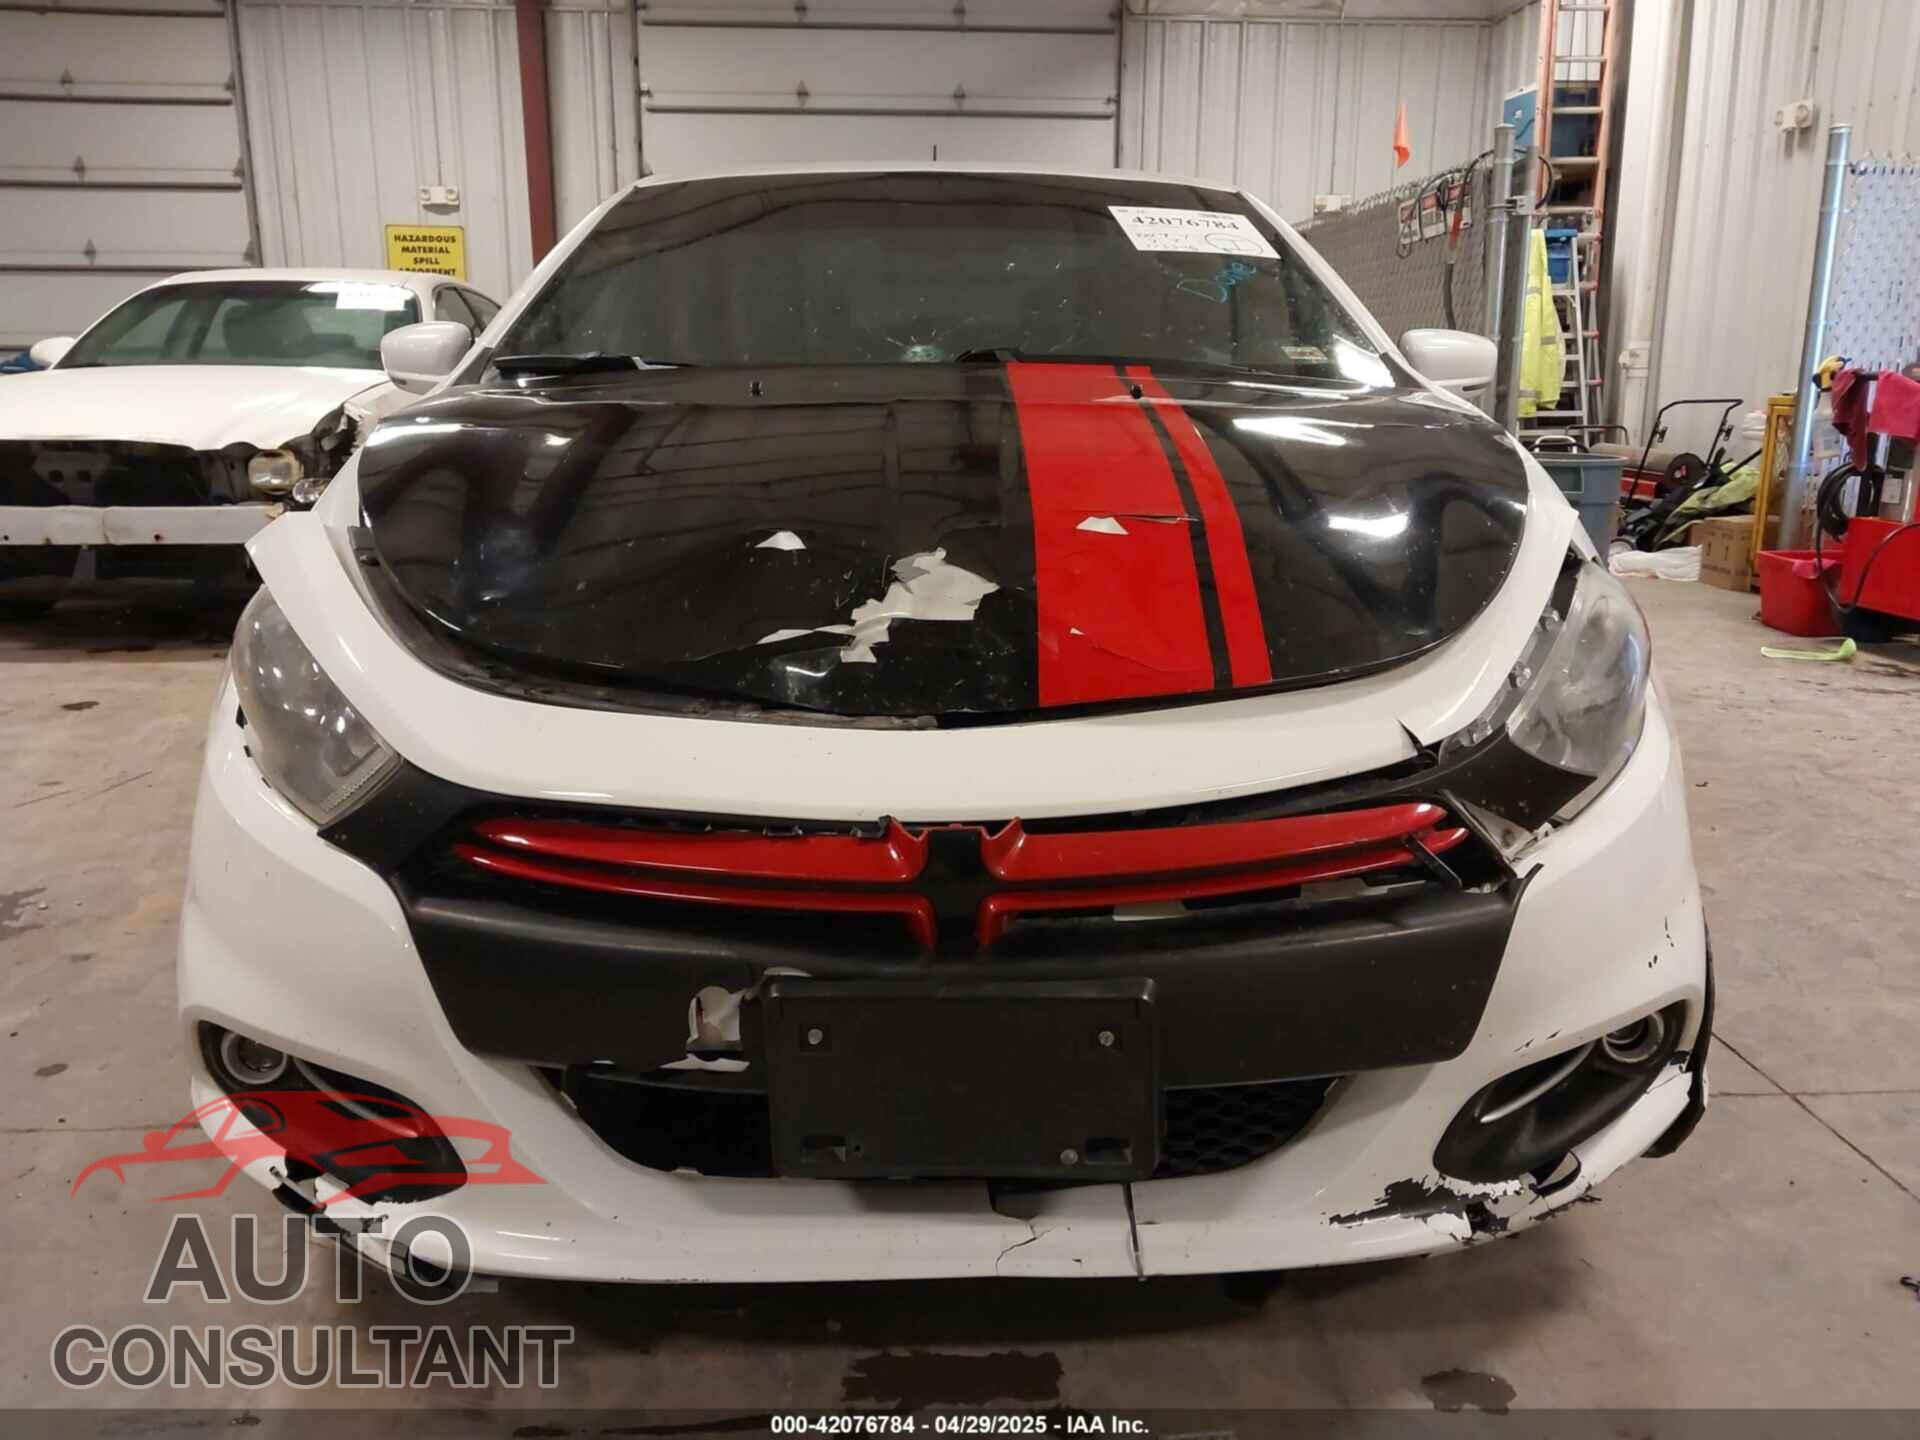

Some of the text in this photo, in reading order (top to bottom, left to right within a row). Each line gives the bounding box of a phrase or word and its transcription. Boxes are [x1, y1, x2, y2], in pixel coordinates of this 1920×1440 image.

[1132, 215, 1240, 231] 42076784
[393, 234, 456, 243] HAZARDOUS
[401, 245, 450, 254] MATERIAL
[413, 256, 440, 265] SPILL
